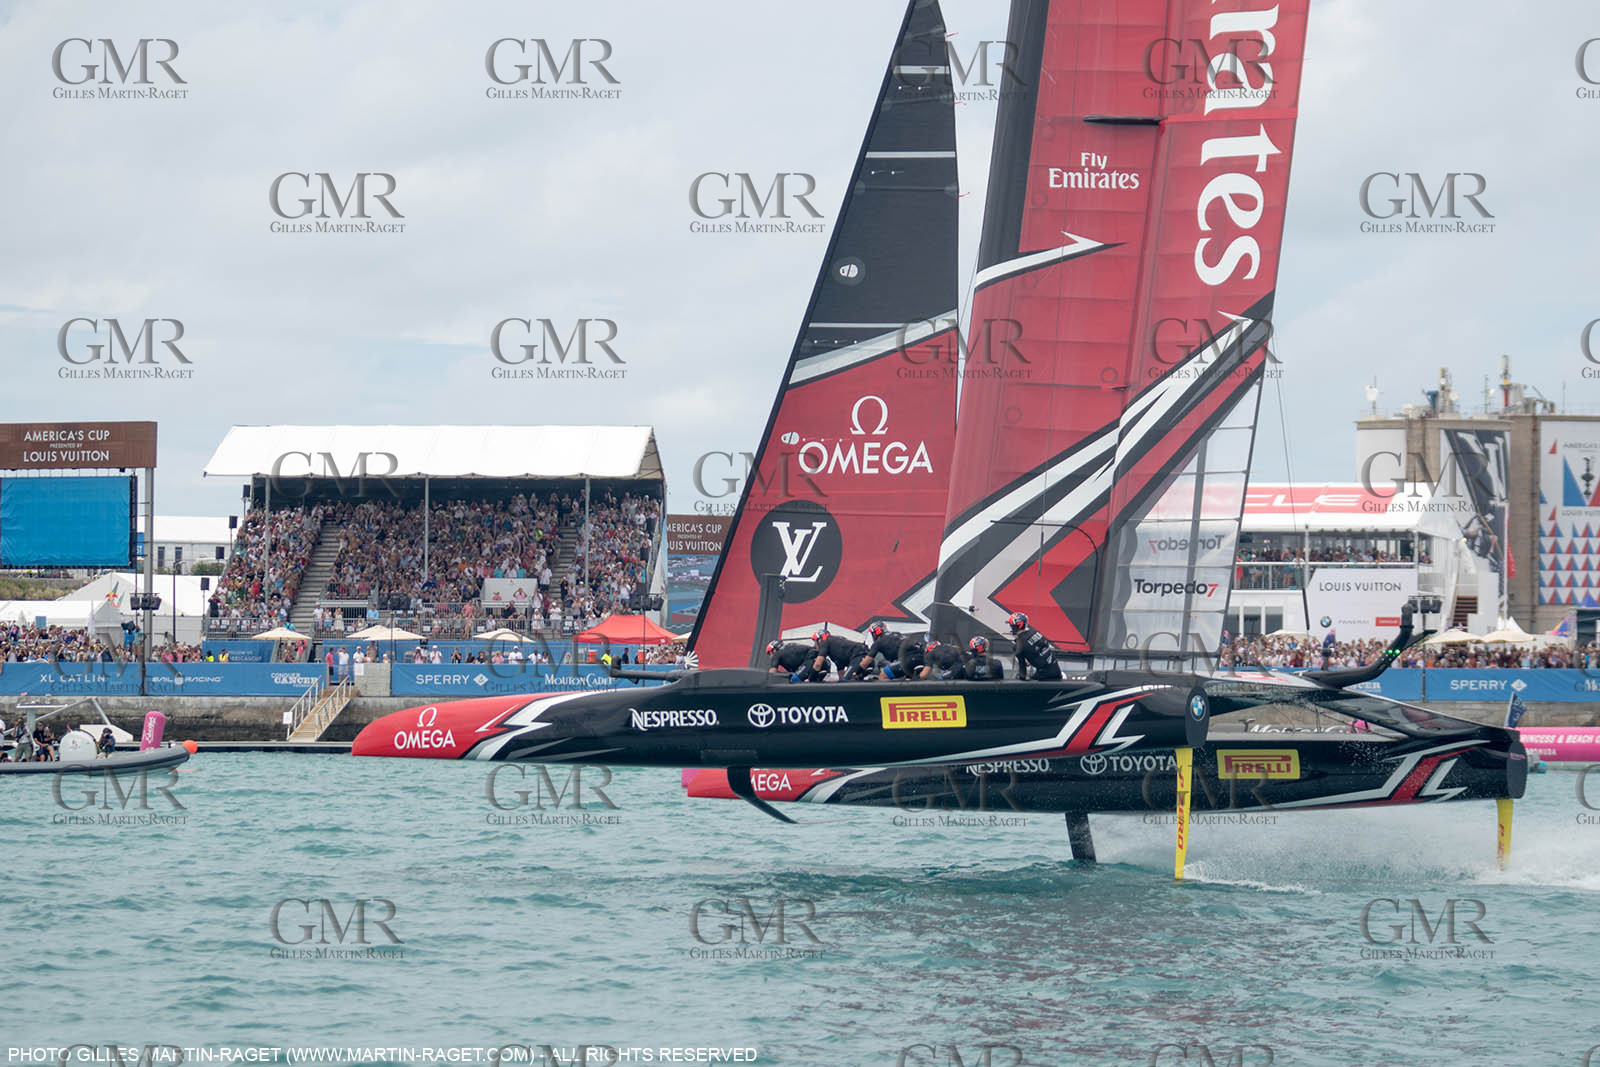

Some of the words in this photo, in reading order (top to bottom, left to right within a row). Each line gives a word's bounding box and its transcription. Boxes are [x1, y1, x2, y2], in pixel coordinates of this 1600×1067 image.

[1194, 0, 1283, 286] rates
[1081, 152, 1107, 170] Fly
[1048, 168, 1140, 190] Emirates
[24, 430, 84, 442] AMERICA'S
[88, 430, 110, 441] CUP
[24, 451, 57, 463] LOUIS
[60, 450, 110, 462] VUITTON
[798, 440, 934, 474] OMEGA
[667, 523, 704, 534] MERICA'S
[706, 524, 722, 534] CUP
[667, 540, 684, 550] UIS
[684, 541, 722, 552] VUITTON
[1134, 578, 1218, 598] Torpedo7
[1319, 582, 1350, 592] LOUIS
[1352, 582, 1401, 592] VUITTON
[40, 674, 55, 682] XL
[60, 674, 106, 682] CATLIN
[416, 674, 470, 685] SPERRY
[1450, 679, 1508, 690] SPERRY
[778, 706, 849, 724] TOYOTA
[889, 701, 958, 723] PIRELLI
[394, 728, 456, 750] OMEGA
[1109, 755, 1178, 772] TOYOTA
[1224, 754, 1292, 775] PIRELLI
